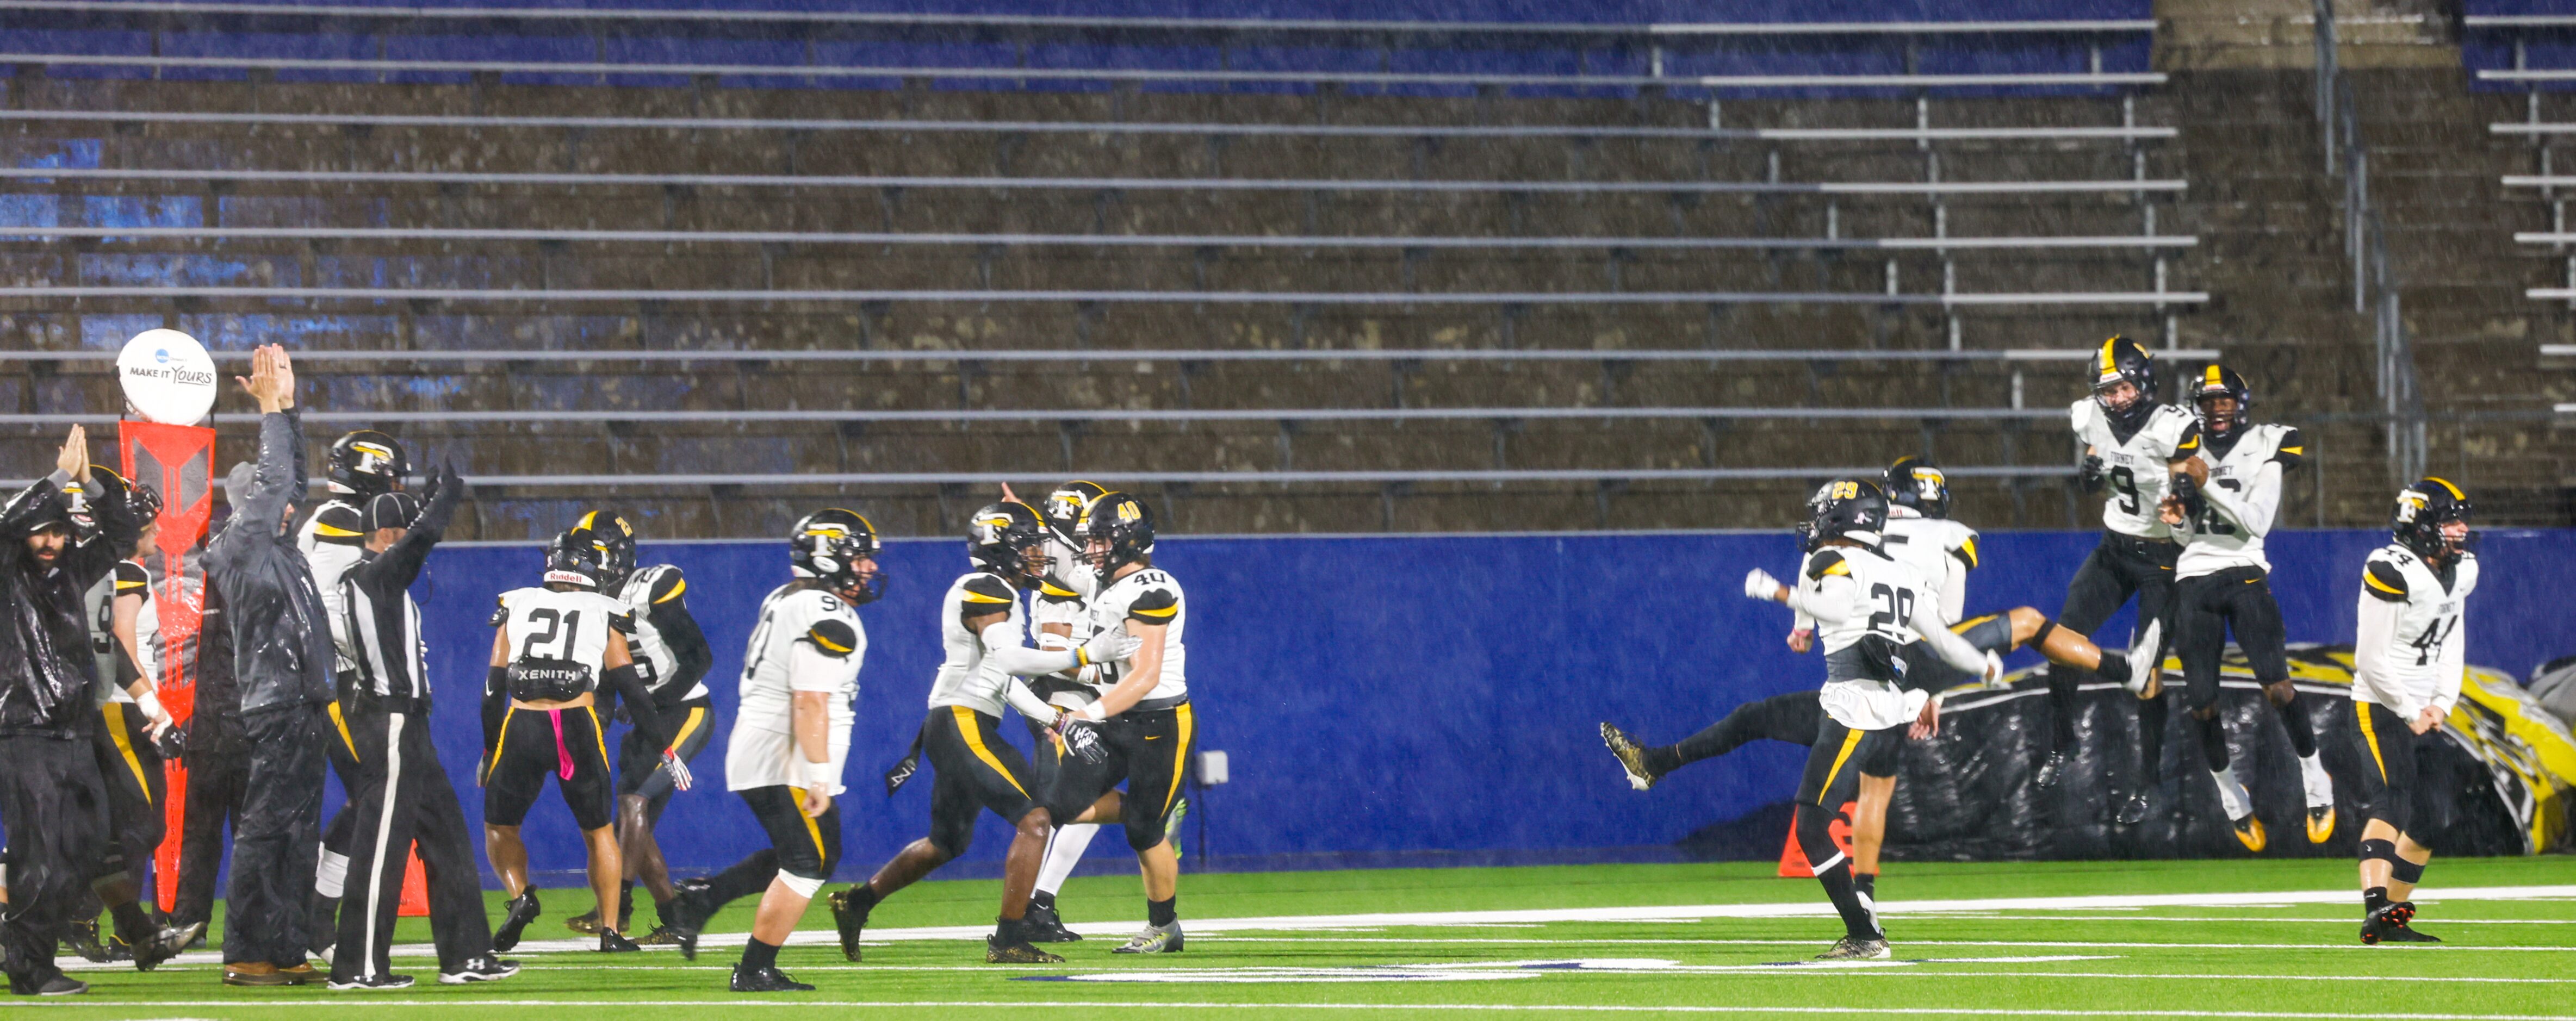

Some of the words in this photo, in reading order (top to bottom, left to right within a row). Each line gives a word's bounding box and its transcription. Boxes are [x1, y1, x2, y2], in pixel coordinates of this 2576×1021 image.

[130, 367, 159, 377] MAKE
[171, 365, 212, 385] YOURS
[1832, 481, 1859, 500] 29
[2111, 465, 2140, 516] 9
[1117, 500, 1142, 524] 40
[550, 573, 582, 583] Riddell
[1134, 572, 1165, 586] 40
[522, 607, 580, 660] 21
[518, 669, 576, 681] XENITH
